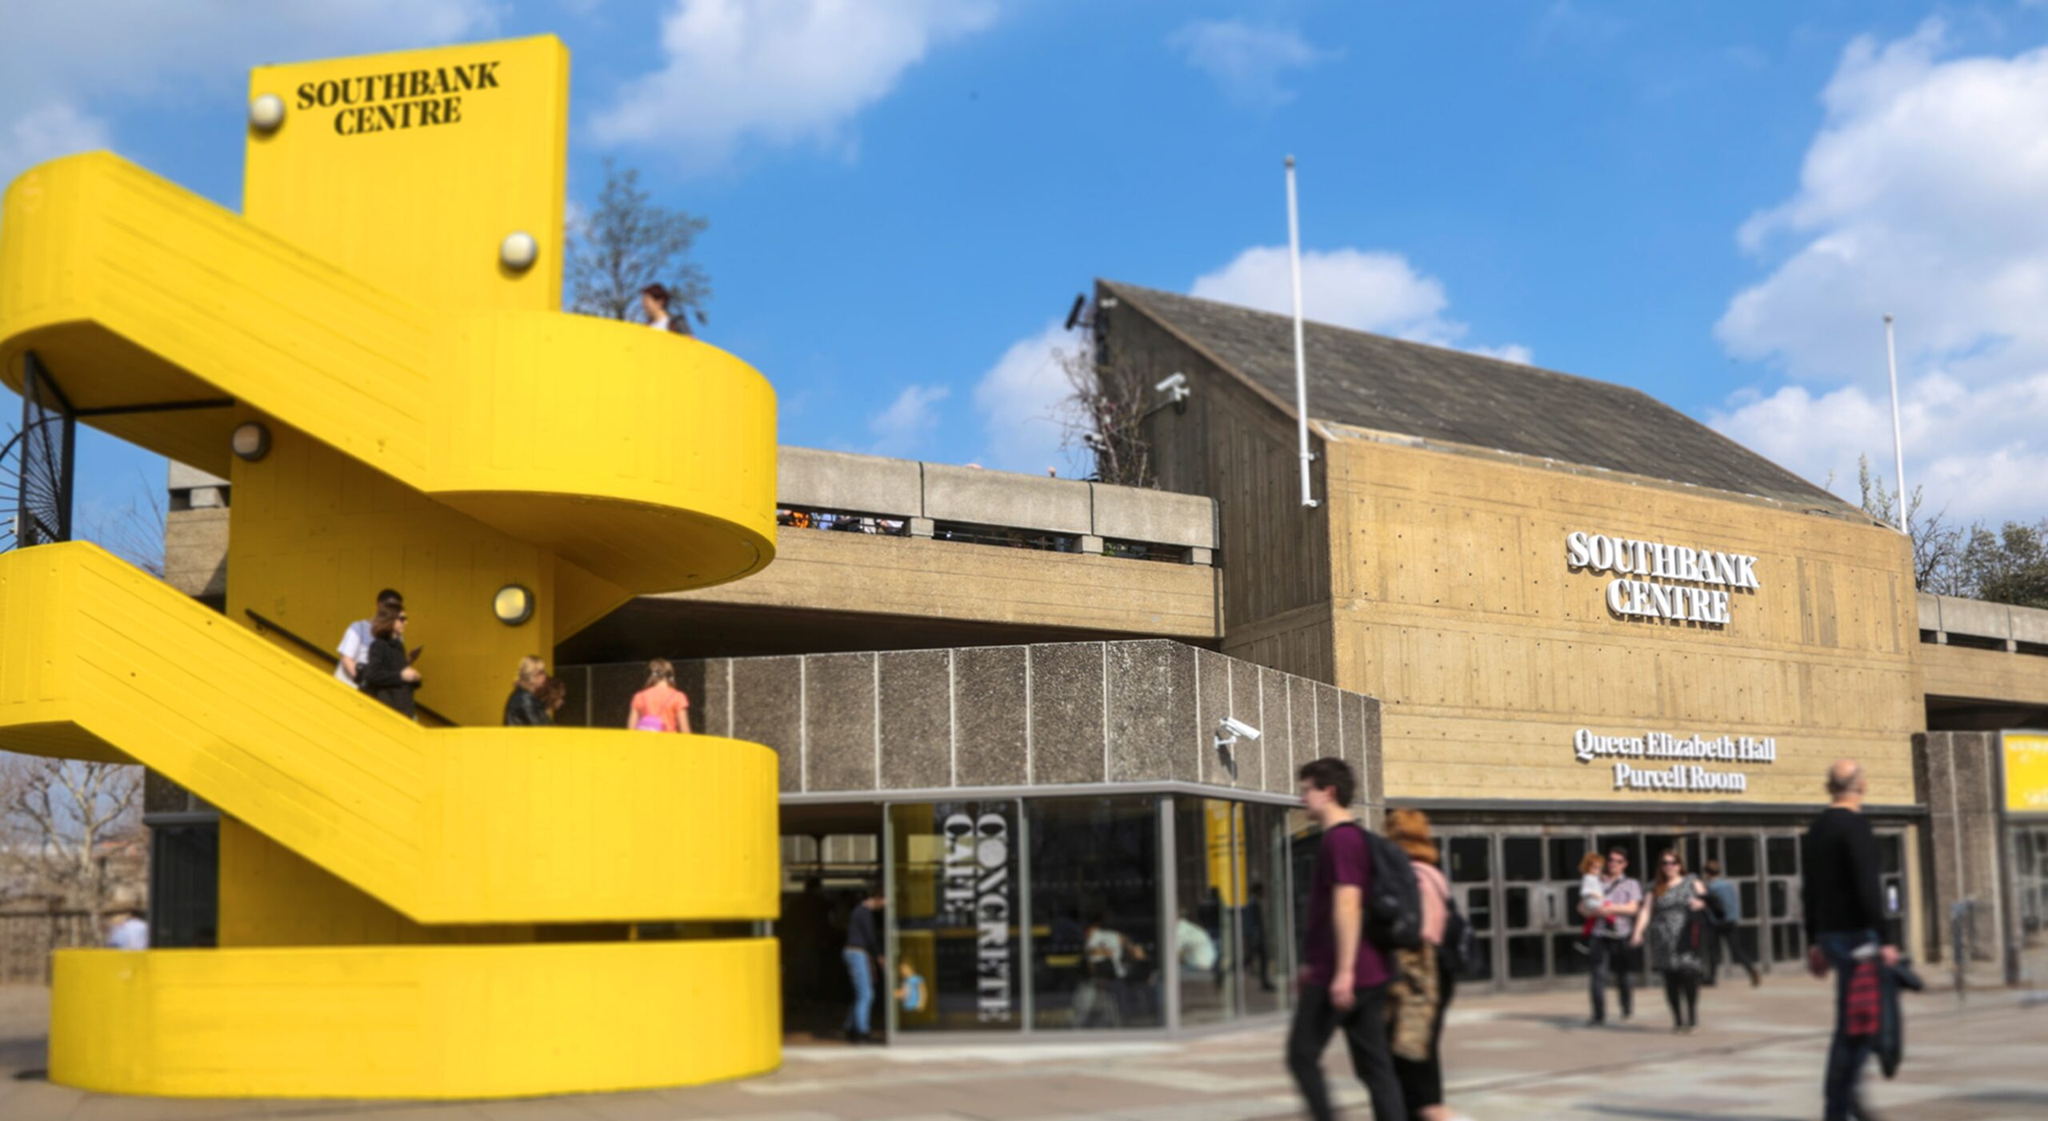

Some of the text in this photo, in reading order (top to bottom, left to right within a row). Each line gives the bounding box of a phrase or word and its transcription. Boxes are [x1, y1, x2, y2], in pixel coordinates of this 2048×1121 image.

[296, 60, 501, 110] SOUTHBANK
[334, 96, 462, 136] CENTRE
[1566, 531, 1761, 589] SOUTHBANK
[1606, 578, 1731, 625] CENTRE
[1575, 728, 1776, 761] Queen Elizabeth Hall
[1614, 763, 1746, 791] Purcell Room
[944, 813, 974, 912] CAFE
[976, 813, 1011, 1023] CONCRETE
